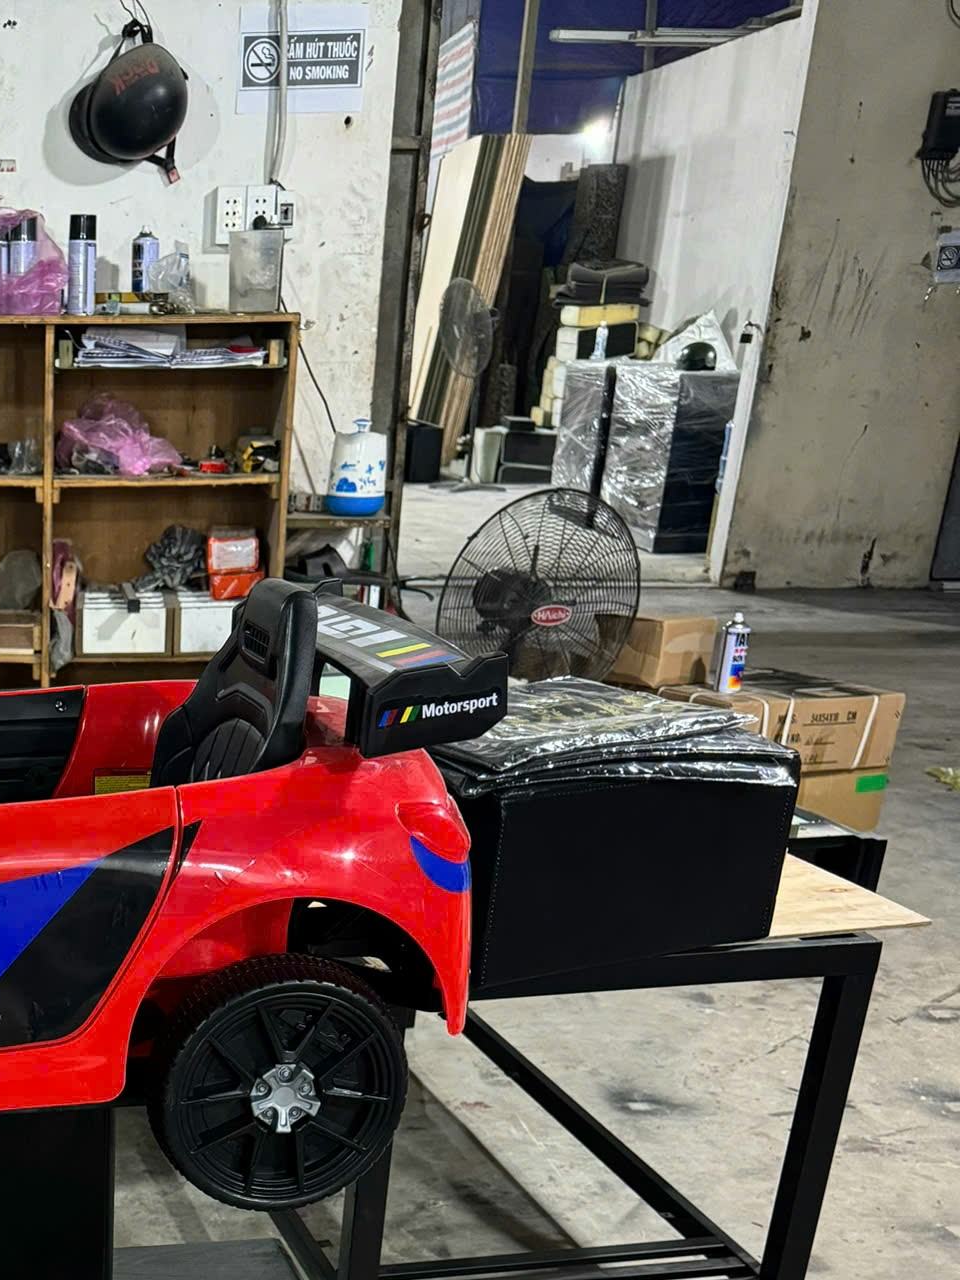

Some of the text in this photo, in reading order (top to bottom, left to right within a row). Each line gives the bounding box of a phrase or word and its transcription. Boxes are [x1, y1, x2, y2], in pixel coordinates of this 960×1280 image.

[287, 35, 358, 59] ẤM HÚT THUỐC
[289, 65, 349, 80] NO SMOKING
[422, 693, 498, 719] Motorsport
